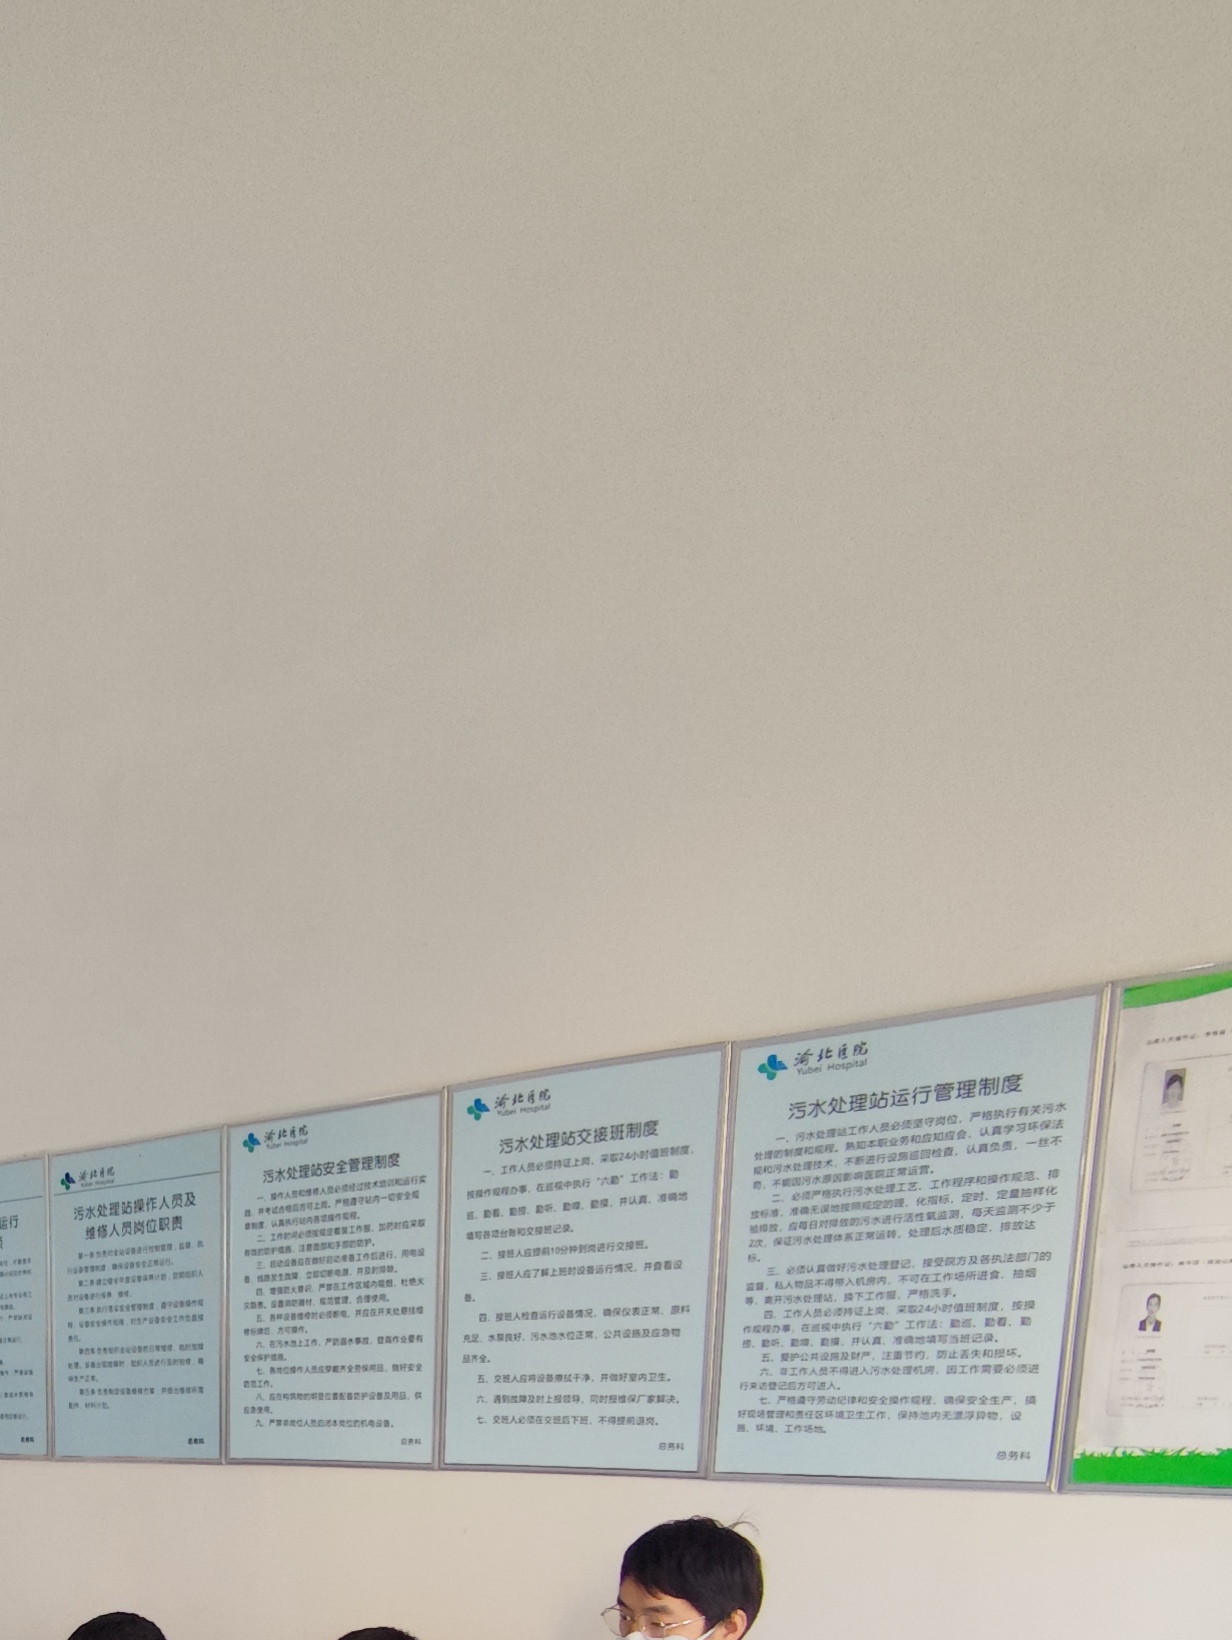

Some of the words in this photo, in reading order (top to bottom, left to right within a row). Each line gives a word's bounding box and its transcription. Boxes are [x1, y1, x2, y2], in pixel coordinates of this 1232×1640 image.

[796, 1063, 823, 1076] Yubei
[826, 1057, 868, 1072] Hospital
[787, 1072, 1025, 1120] 污水处理站运行管理制度
[499, 1119, 660, 1154] 污水处理站交接班制度
[262, 1152, 401, 1184] 污水处理站安全管理制度
[73, 1191, 197, 1221] 污水处理站操作人员及
[85, 1215, 183, 1240] 维修人员岗位职责
